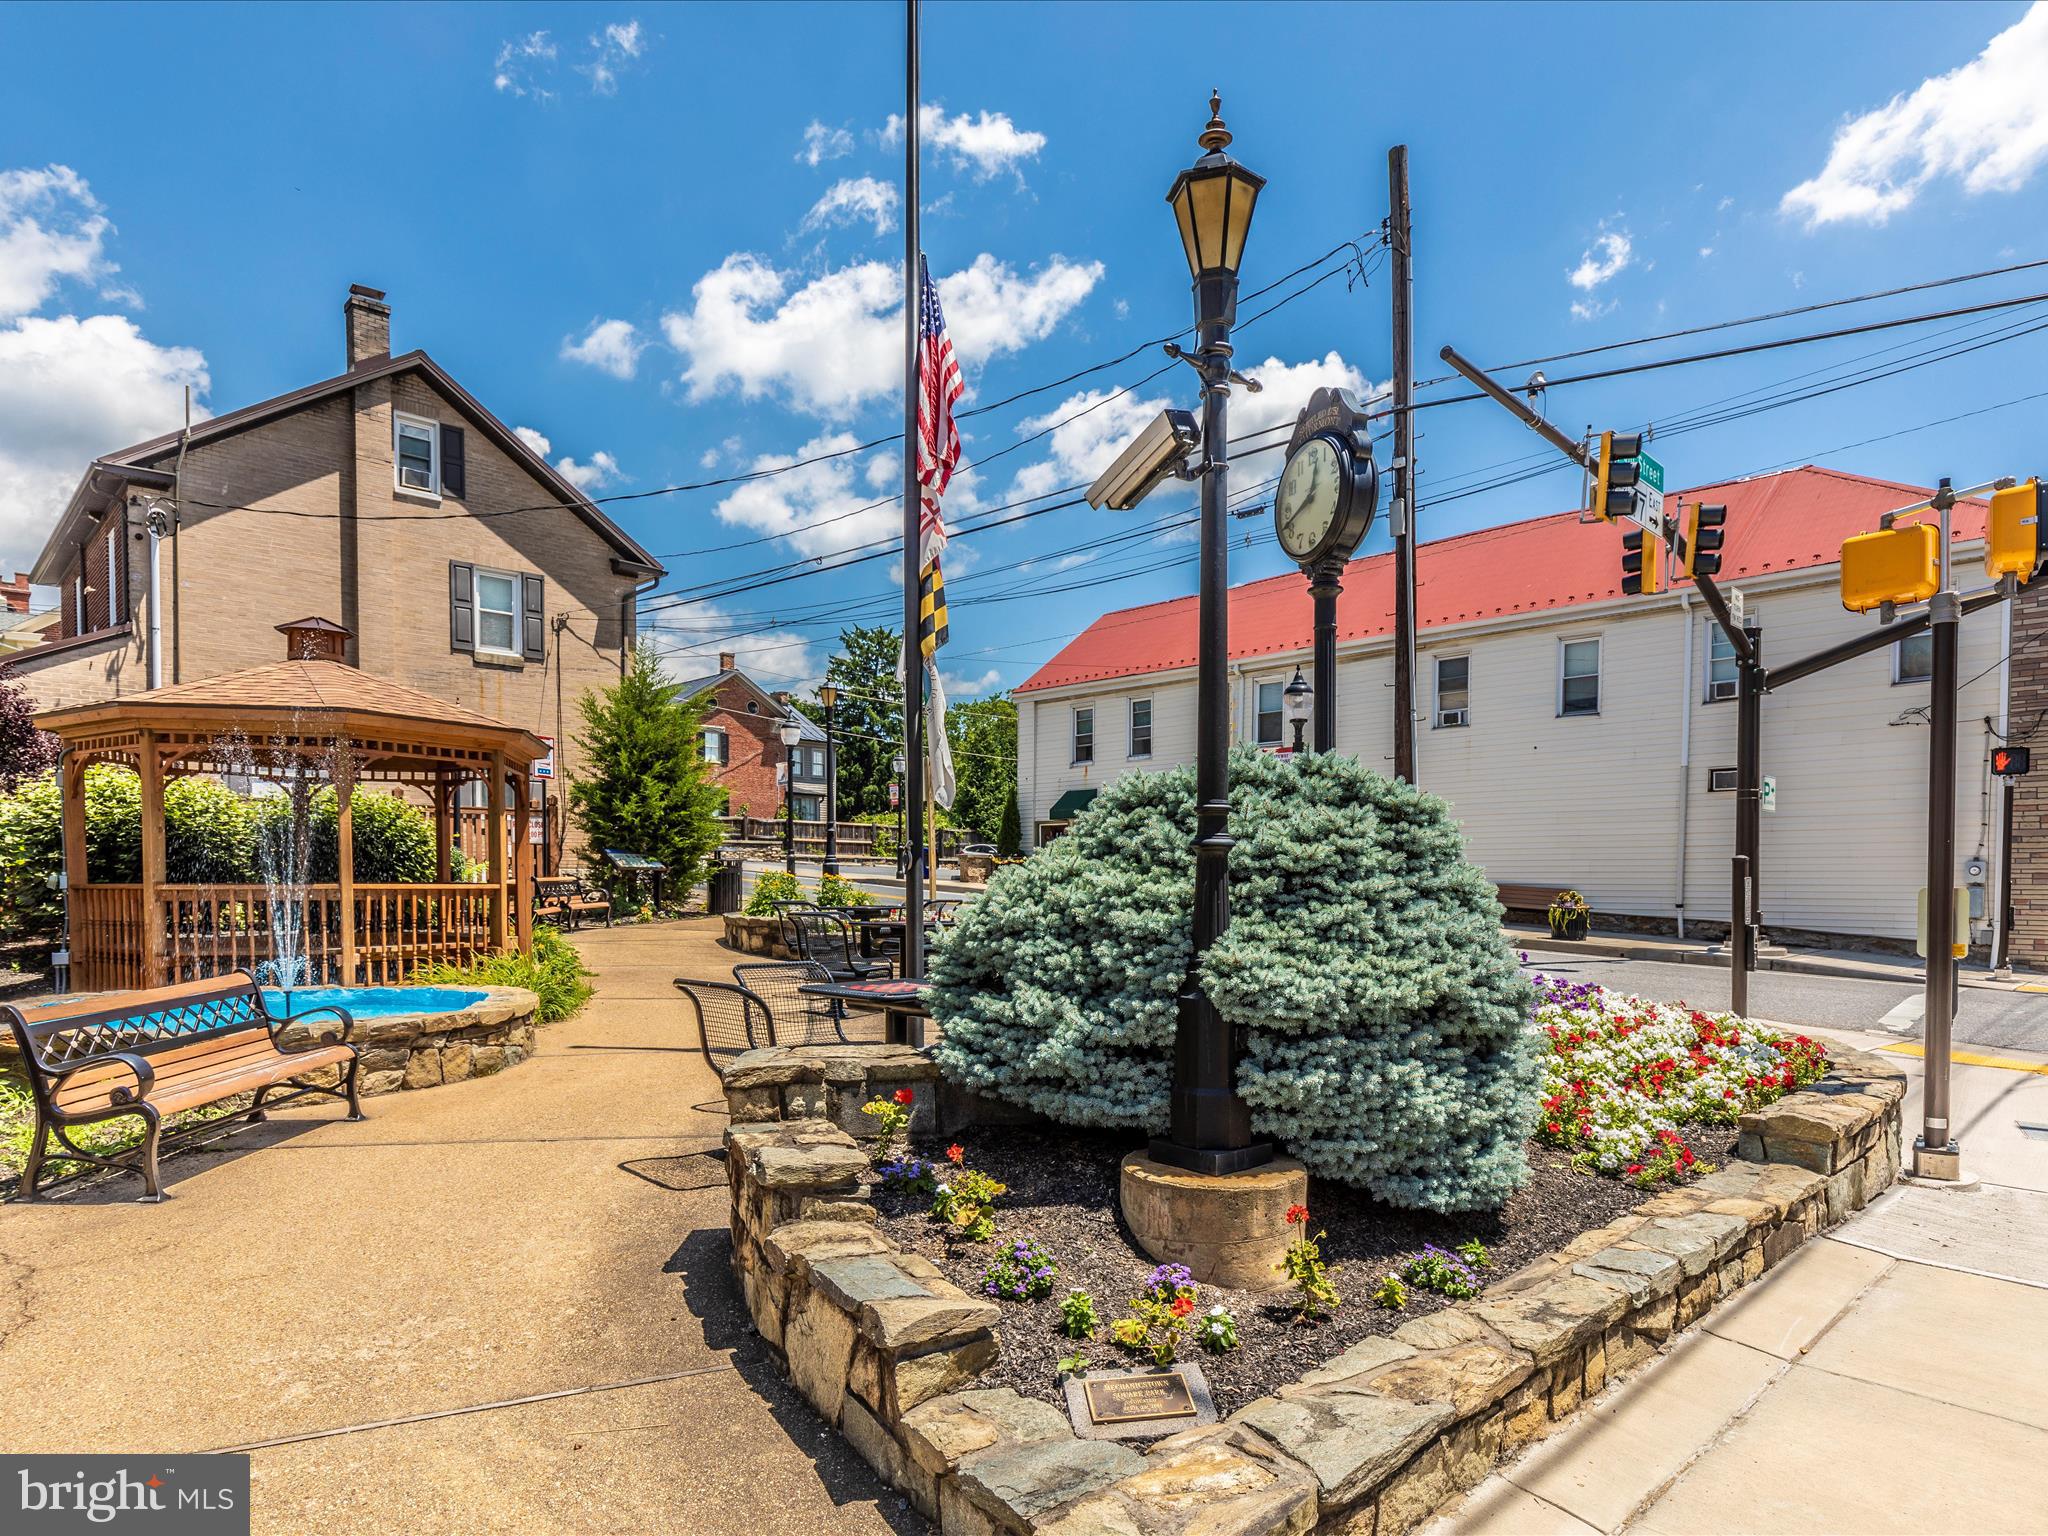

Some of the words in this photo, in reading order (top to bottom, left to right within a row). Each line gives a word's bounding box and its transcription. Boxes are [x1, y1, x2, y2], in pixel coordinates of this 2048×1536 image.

[1309, 447, 1318, 466] 12
[1297, 461, 1304, 478] 11
[1638, 455, 1660, 485] Street
[1289, 480, 1296, 497] 10
[1649, 492, 1661, 512] EAST
[1284, 503, 1291, 520] 9
[1288, 523, 1295, 539] 8
[1308, 532, 1316, 547] 6
[1297, 533, 1304, 549] 7
[1104, 1380, 1169, 1391] MECHANICSTOWN
[1113, 1391, 1144, 1399] SQUARE
